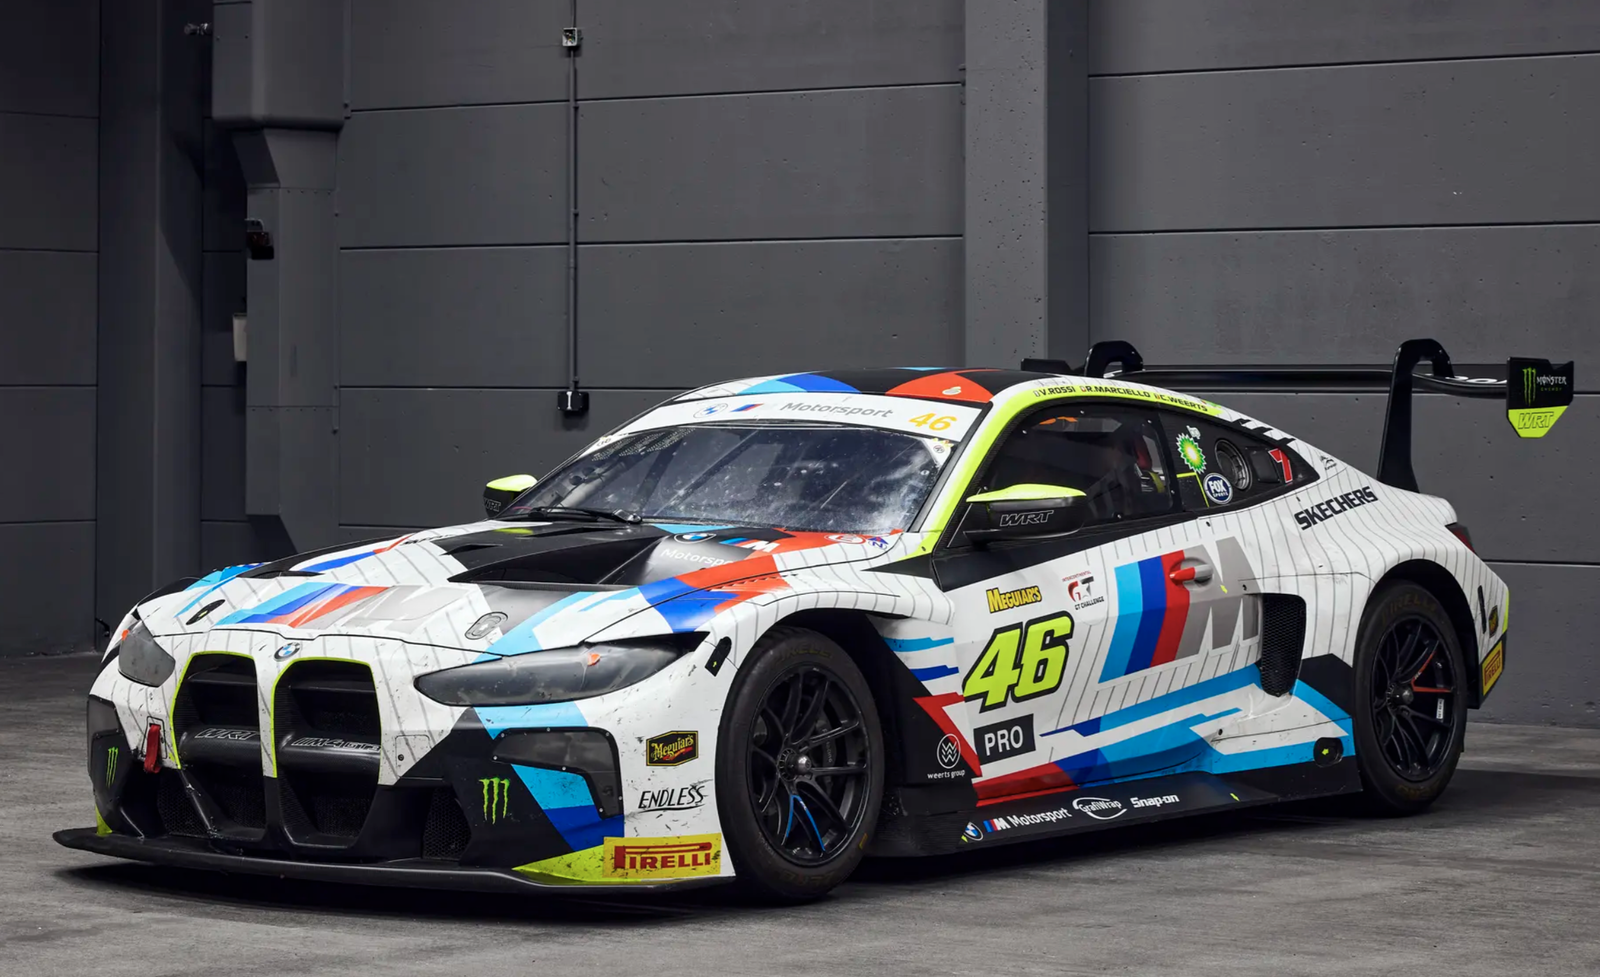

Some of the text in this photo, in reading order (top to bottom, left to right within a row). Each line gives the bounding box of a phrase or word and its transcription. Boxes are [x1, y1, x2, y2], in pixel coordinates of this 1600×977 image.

[1536, 374, 1567, 386] MONSTER
[1040, 386, 1208, 412] V.ROSSI R.MARCIELLO C.WEERTS
[779, 402, 894, 418] Motorsport
[908, 412, 958, 431] 46
[1517, 411, 1554, 430] WRT
[1208, 479, 1228, 494] FOX
[1294, 485, 1379, 530] SKECHERS
[1000, 510, 1054, 527] WRT
[1080, 596, 1105, 608] CHALLENGE
[962, 610, 1075, 713] 46
[651, 735, 694, 762] Meguiar's
[984, 725, 1024, 756] PRO
[927, 769, 966, 779] weerts group
[638, 785, 706, 809] ENDLESS
[1130, 794, 1180, 808] Snap-on
[1009, 807, 1072, 828] Motorsport
[613, 841, 713, 870] PIRELLI
